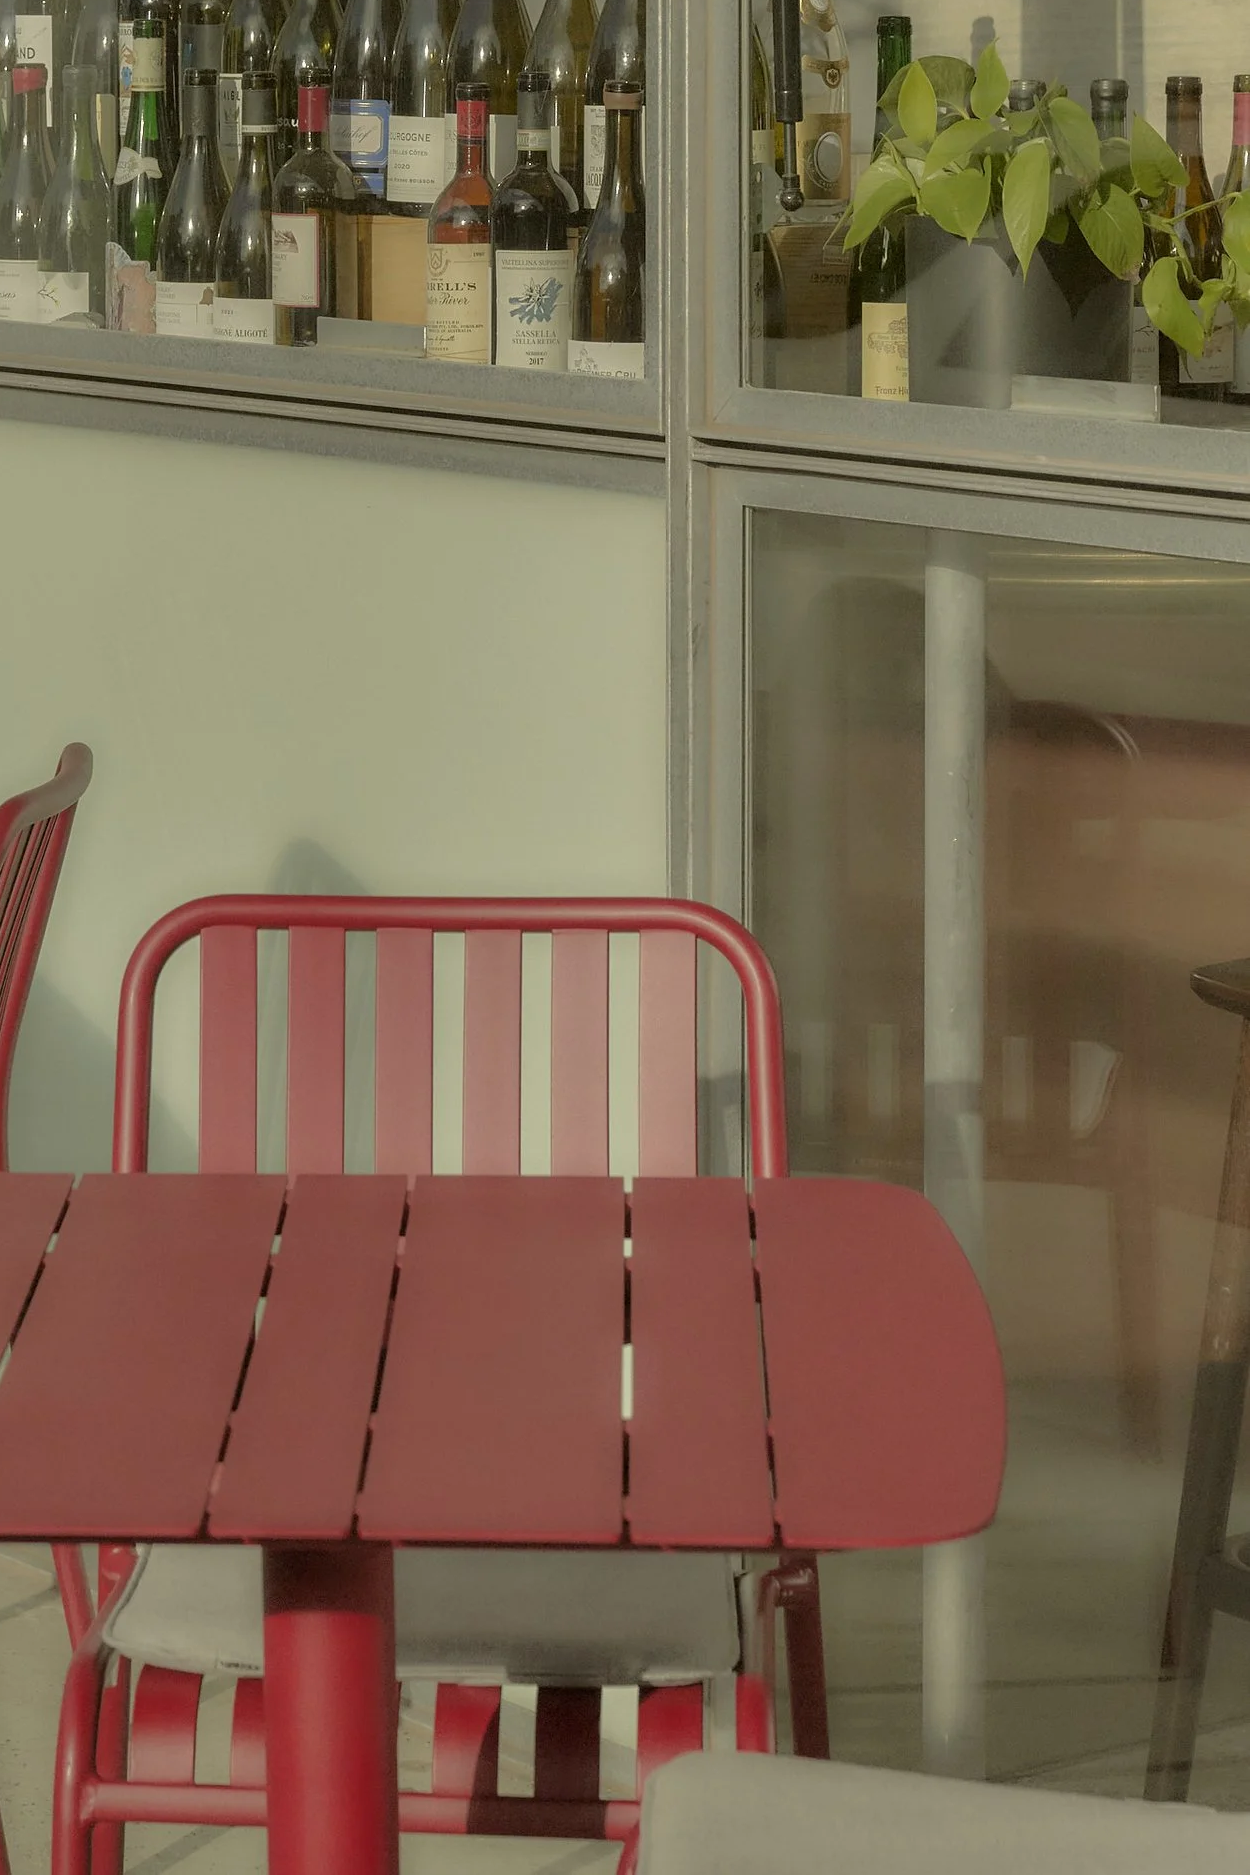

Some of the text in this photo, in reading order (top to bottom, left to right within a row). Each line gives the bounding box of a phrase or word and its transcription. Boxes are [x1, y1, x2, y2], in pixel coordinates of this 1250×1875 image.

[17, 47, 36, 60] ND
[439, 292, 470, 305] River
[234, 327, 268, 338] ALIGOTÉ
[515, 330, 557, 338] SASSELLA
[528, 357, 545, 365] 2017
